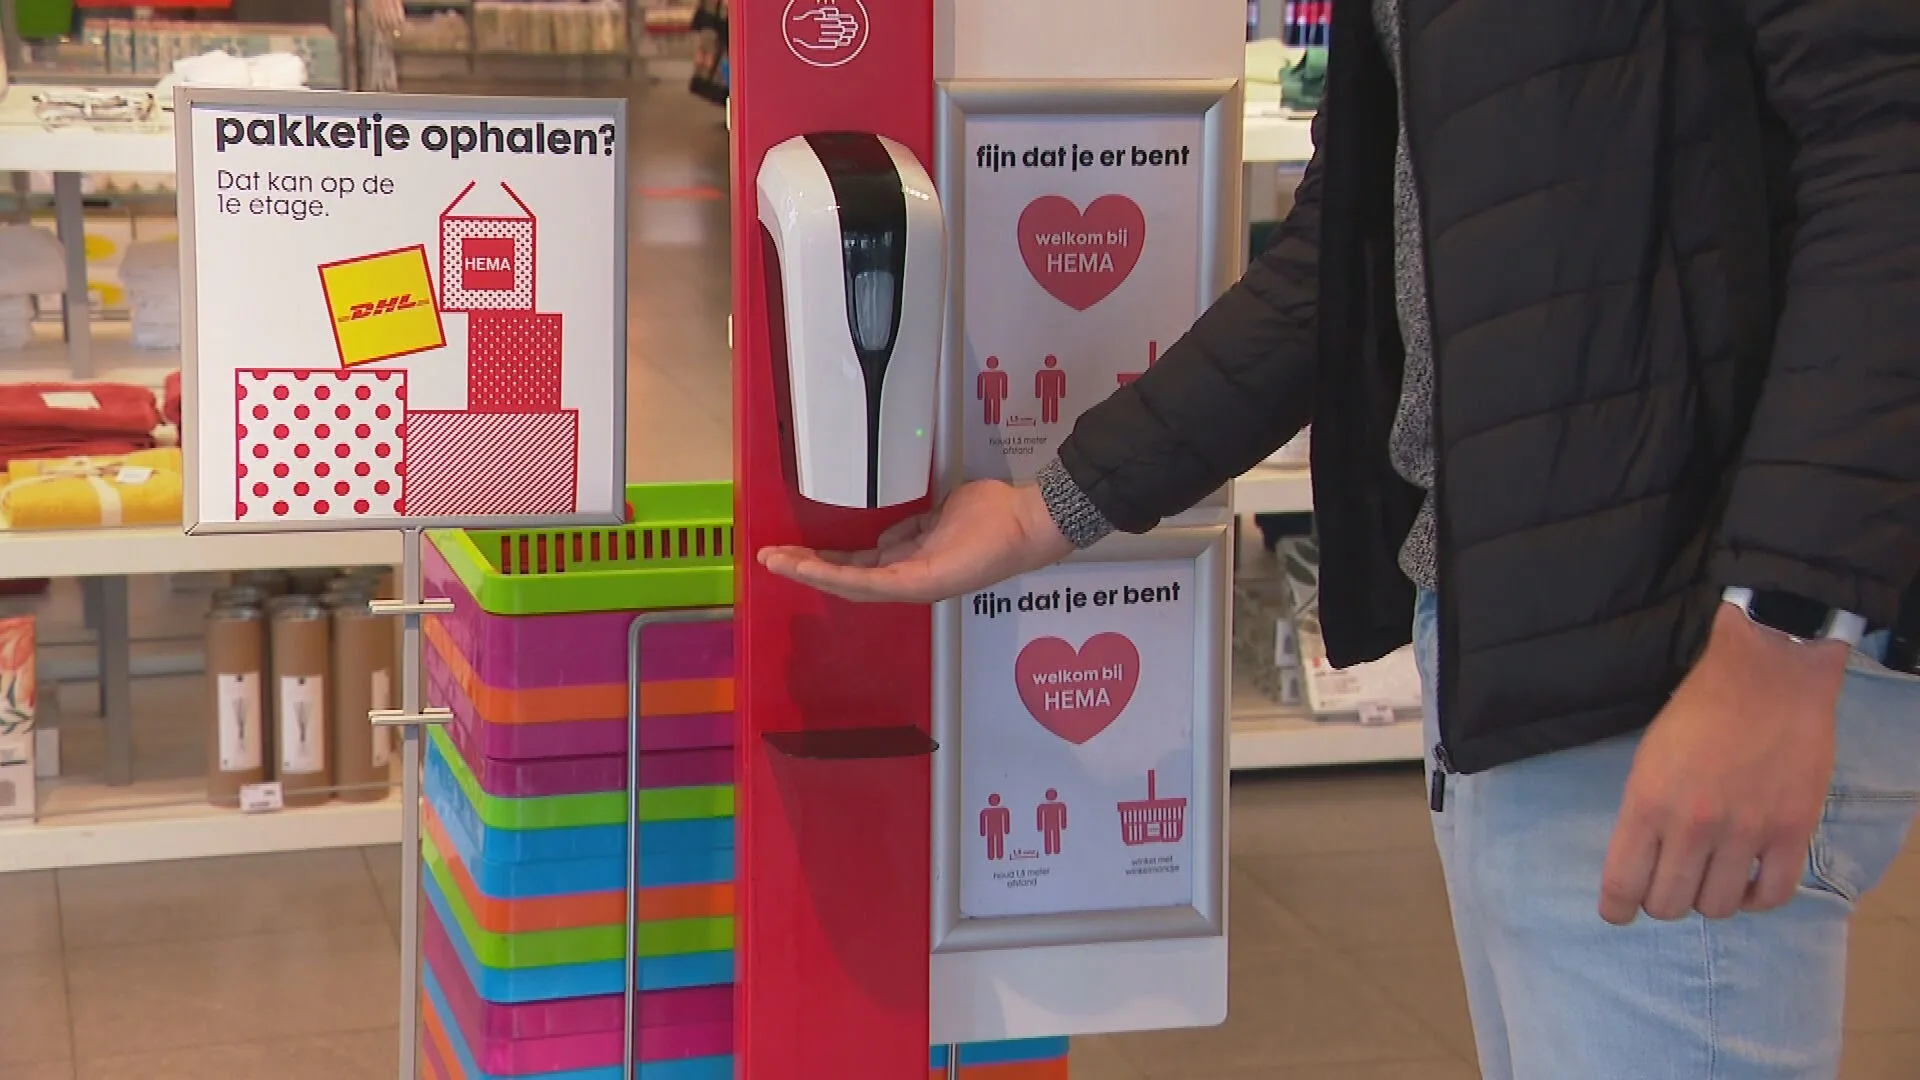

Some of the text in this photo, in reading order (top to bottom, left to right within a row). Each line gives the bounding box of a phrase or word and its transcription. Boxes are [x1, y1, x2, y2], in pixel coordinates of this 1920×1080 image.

[216, 113, 616, 158] pakketje ophalen?
[976, 143, 1190, 172] fijn dat je er bent
[217, 169, 395, 198] Dat kan op de
[217, 194, 330, 220] 1e etage.
[1035, 228, 1128, 247] welkom bij
[465, 257, 512, 271] HEMA
[1046, 253, 1115, 273] HEMA
[350, 293, 417, 320] DHL
[973, 581, 1181, 618] fijn dat je er bent
[1032, 663, 1123, 685] welkom bij
[1044, 687, 1111, 711] HEMA
